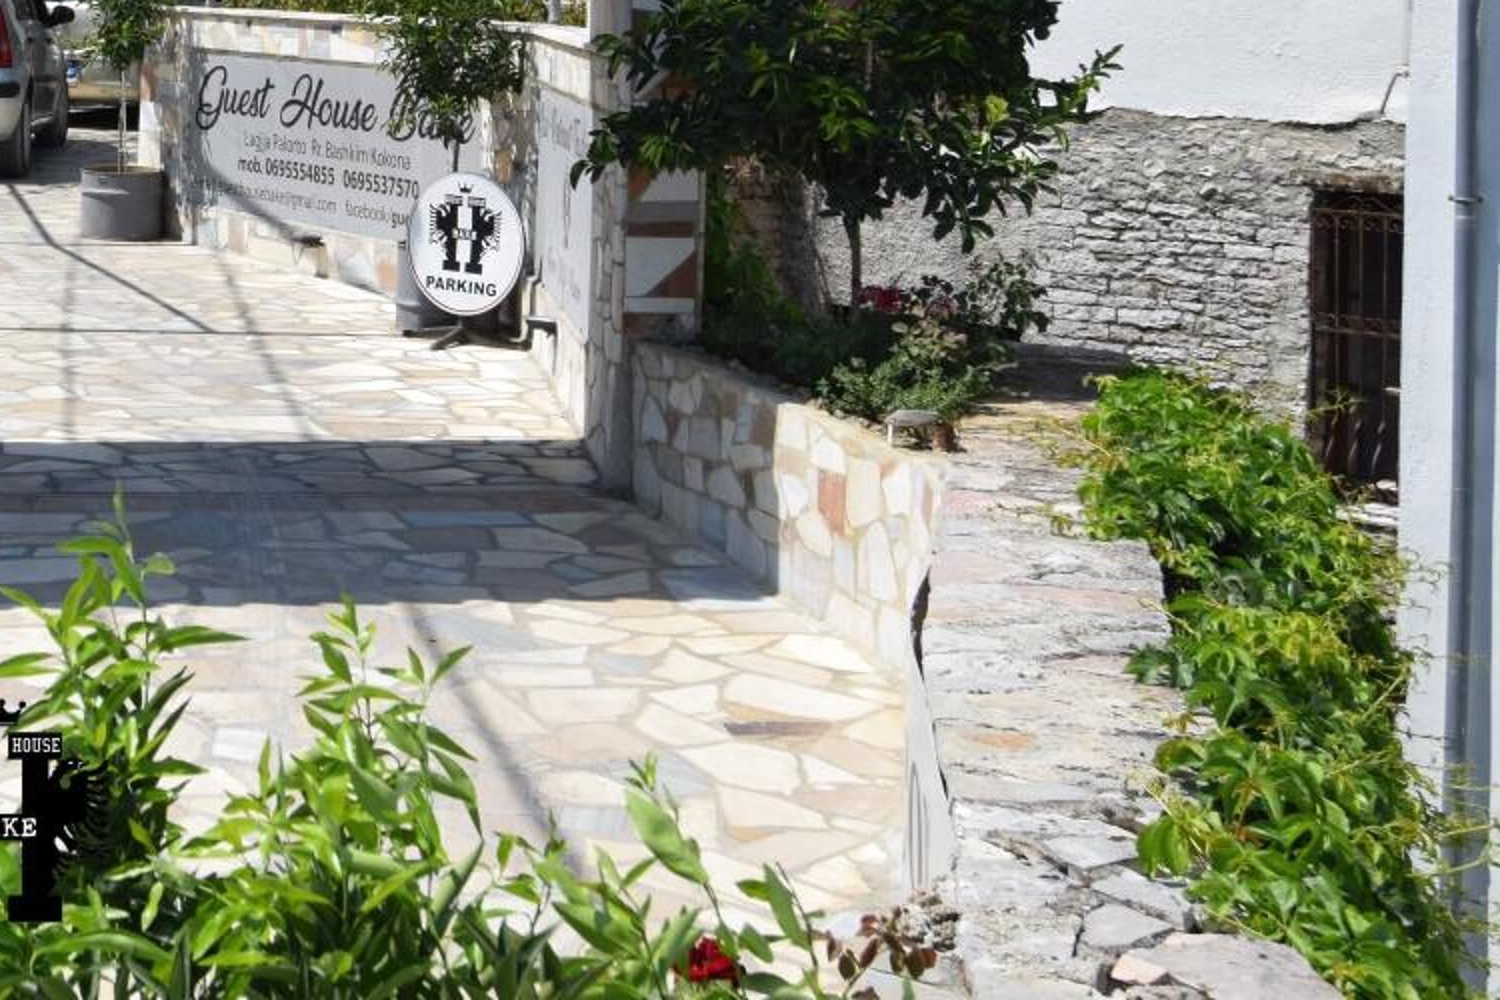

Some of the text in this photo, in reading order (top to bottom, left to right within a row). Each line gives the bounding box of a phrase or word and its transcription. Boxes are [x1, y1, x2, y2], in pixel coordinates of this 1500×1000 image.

[196, 65, 275, 130] Guest
[280, 73, 378, 132] House
[385, 80, 476, 145] Bae
[343, 169, 420, 200] 0695537570
[425, 275, 497, 297] PARKING
